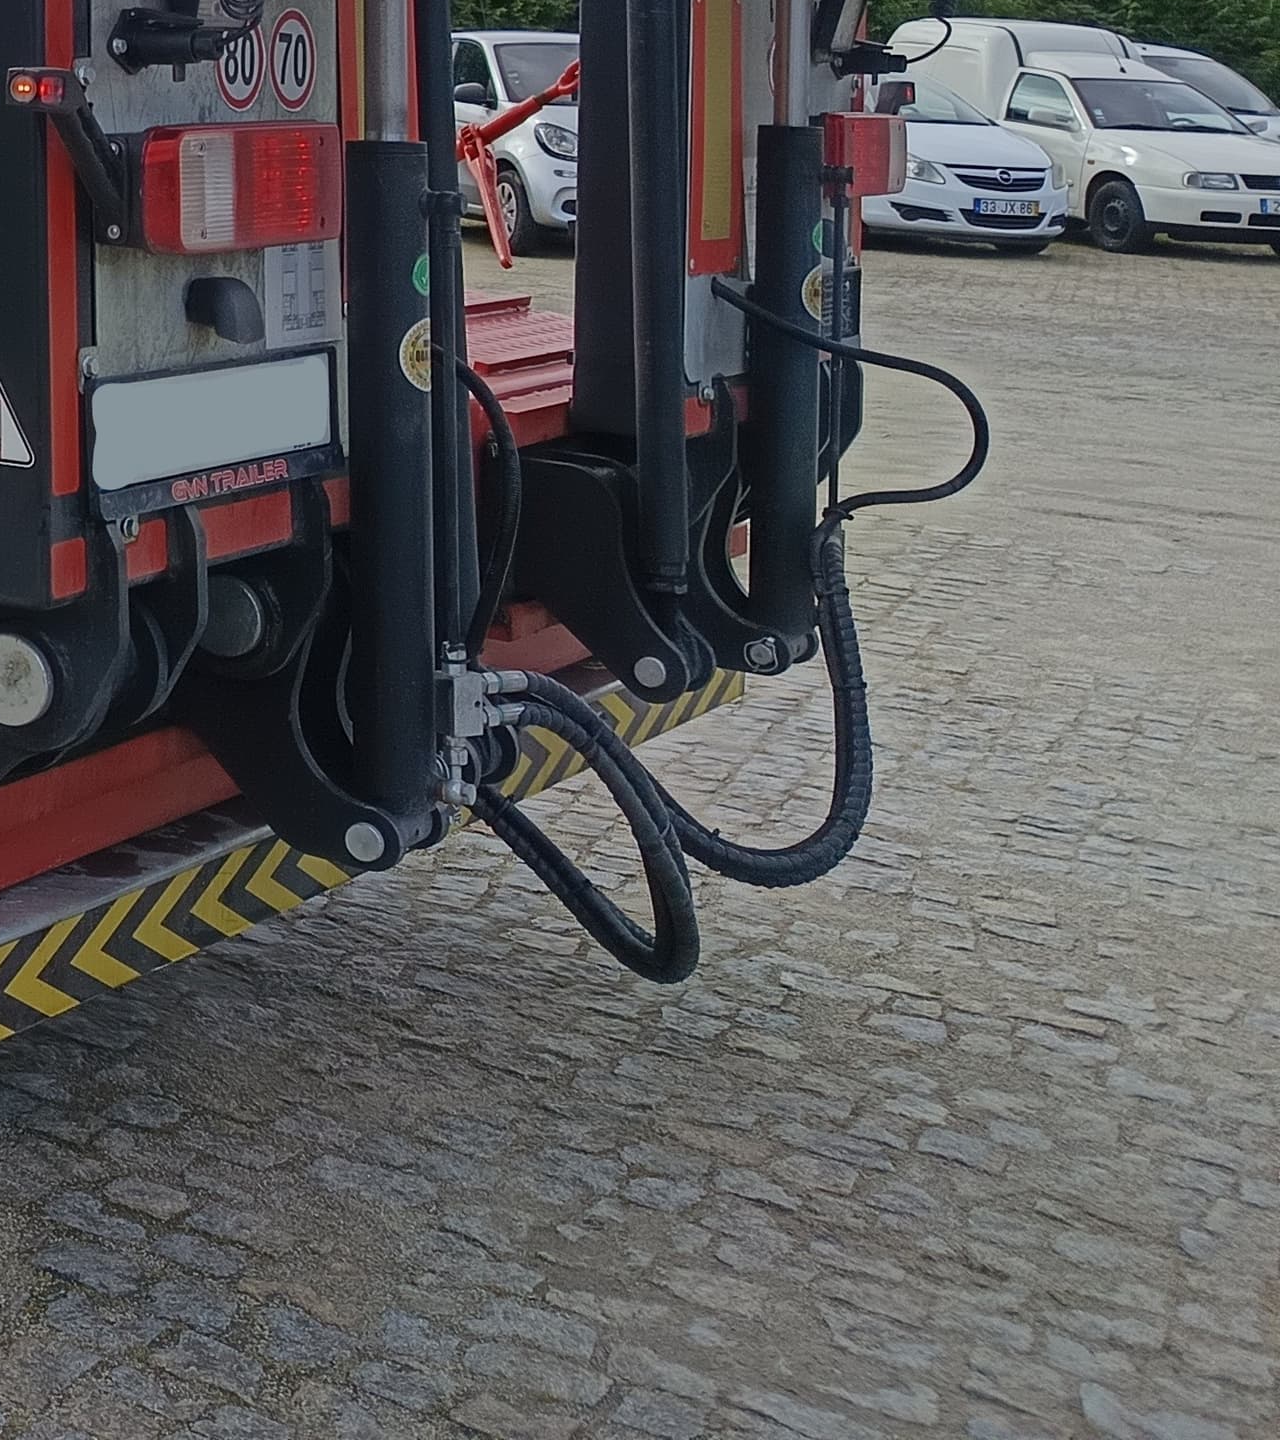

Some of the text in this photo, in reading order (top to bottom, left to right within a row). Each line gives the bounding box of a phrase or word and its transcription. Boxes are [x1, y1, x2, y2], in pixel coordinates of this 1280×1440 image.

[224, 31, 255, 86] 80
[279, 32, 307, 87] 70
[210, 458, 289, 493] TRAILER
